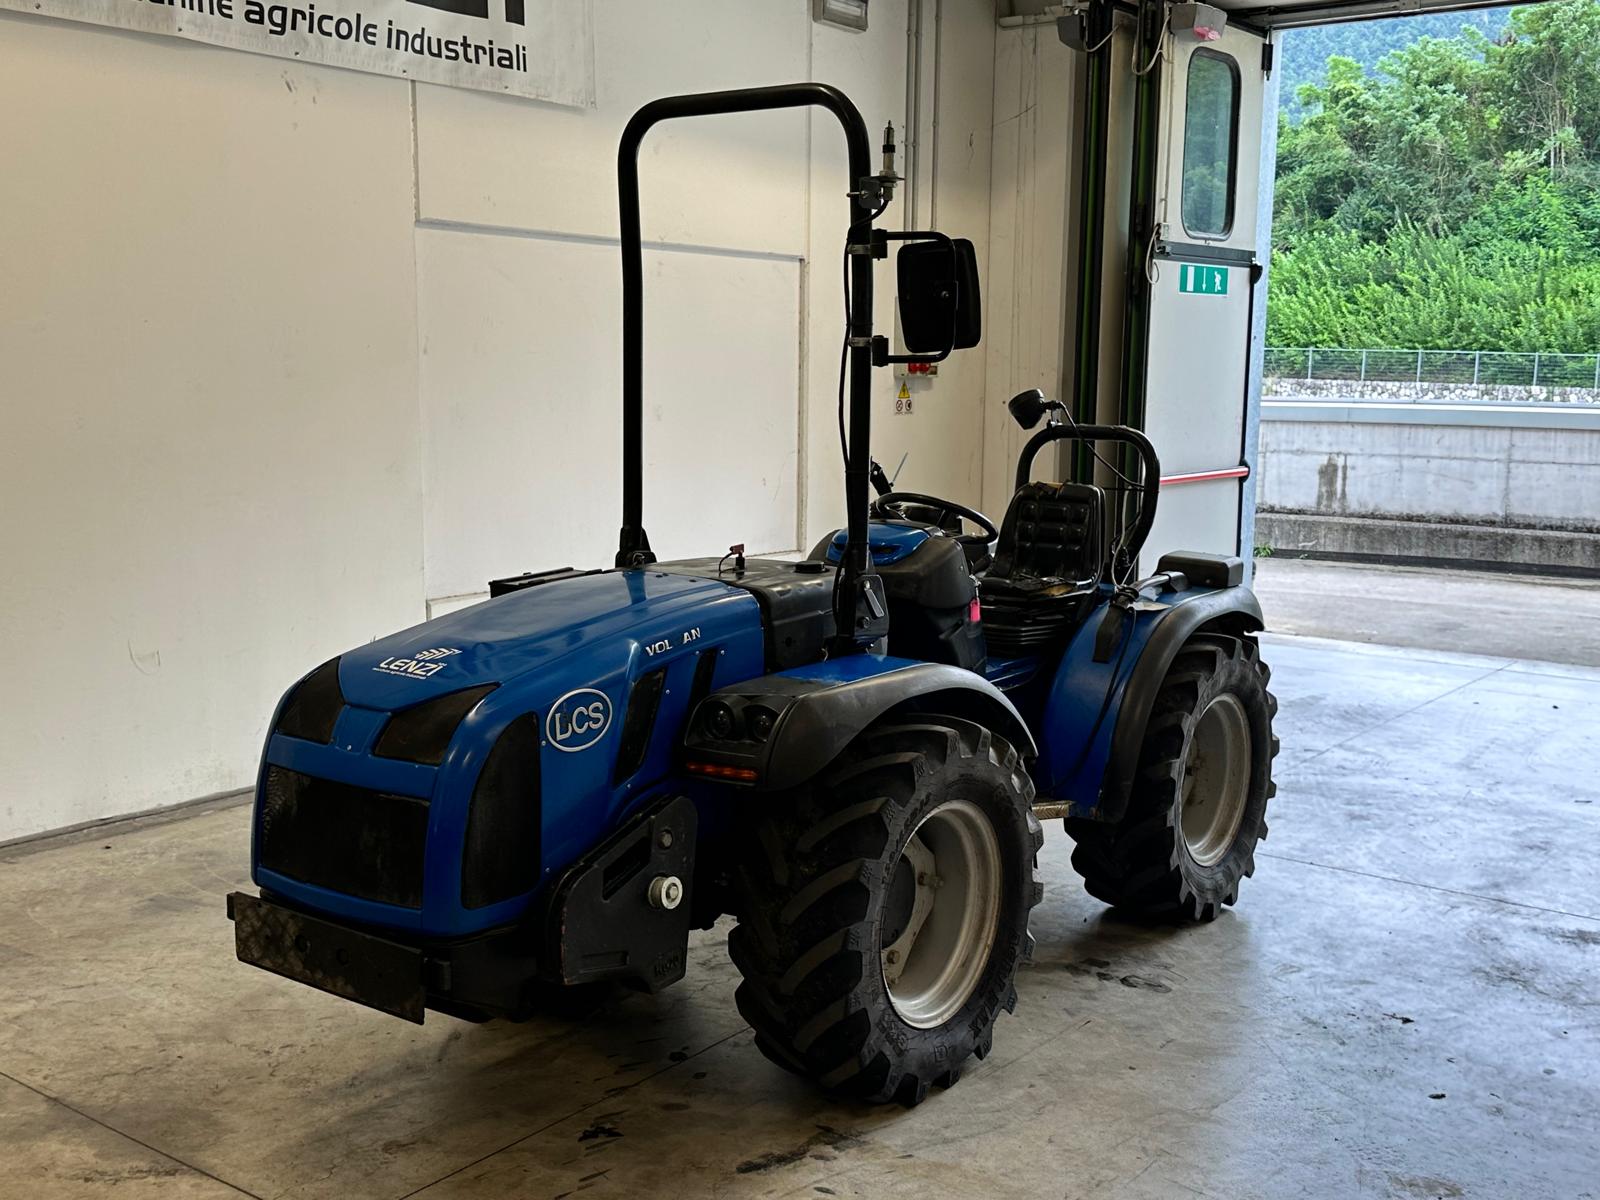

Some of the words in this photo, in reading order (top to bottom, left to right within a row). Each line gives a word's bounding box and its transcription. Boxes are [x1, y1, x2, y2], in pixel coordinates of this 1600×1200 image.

[244, 0, 377, 46] agricole
[386, 20, 527, 72] industriali
[379, 656, 444, 677] LENZI
